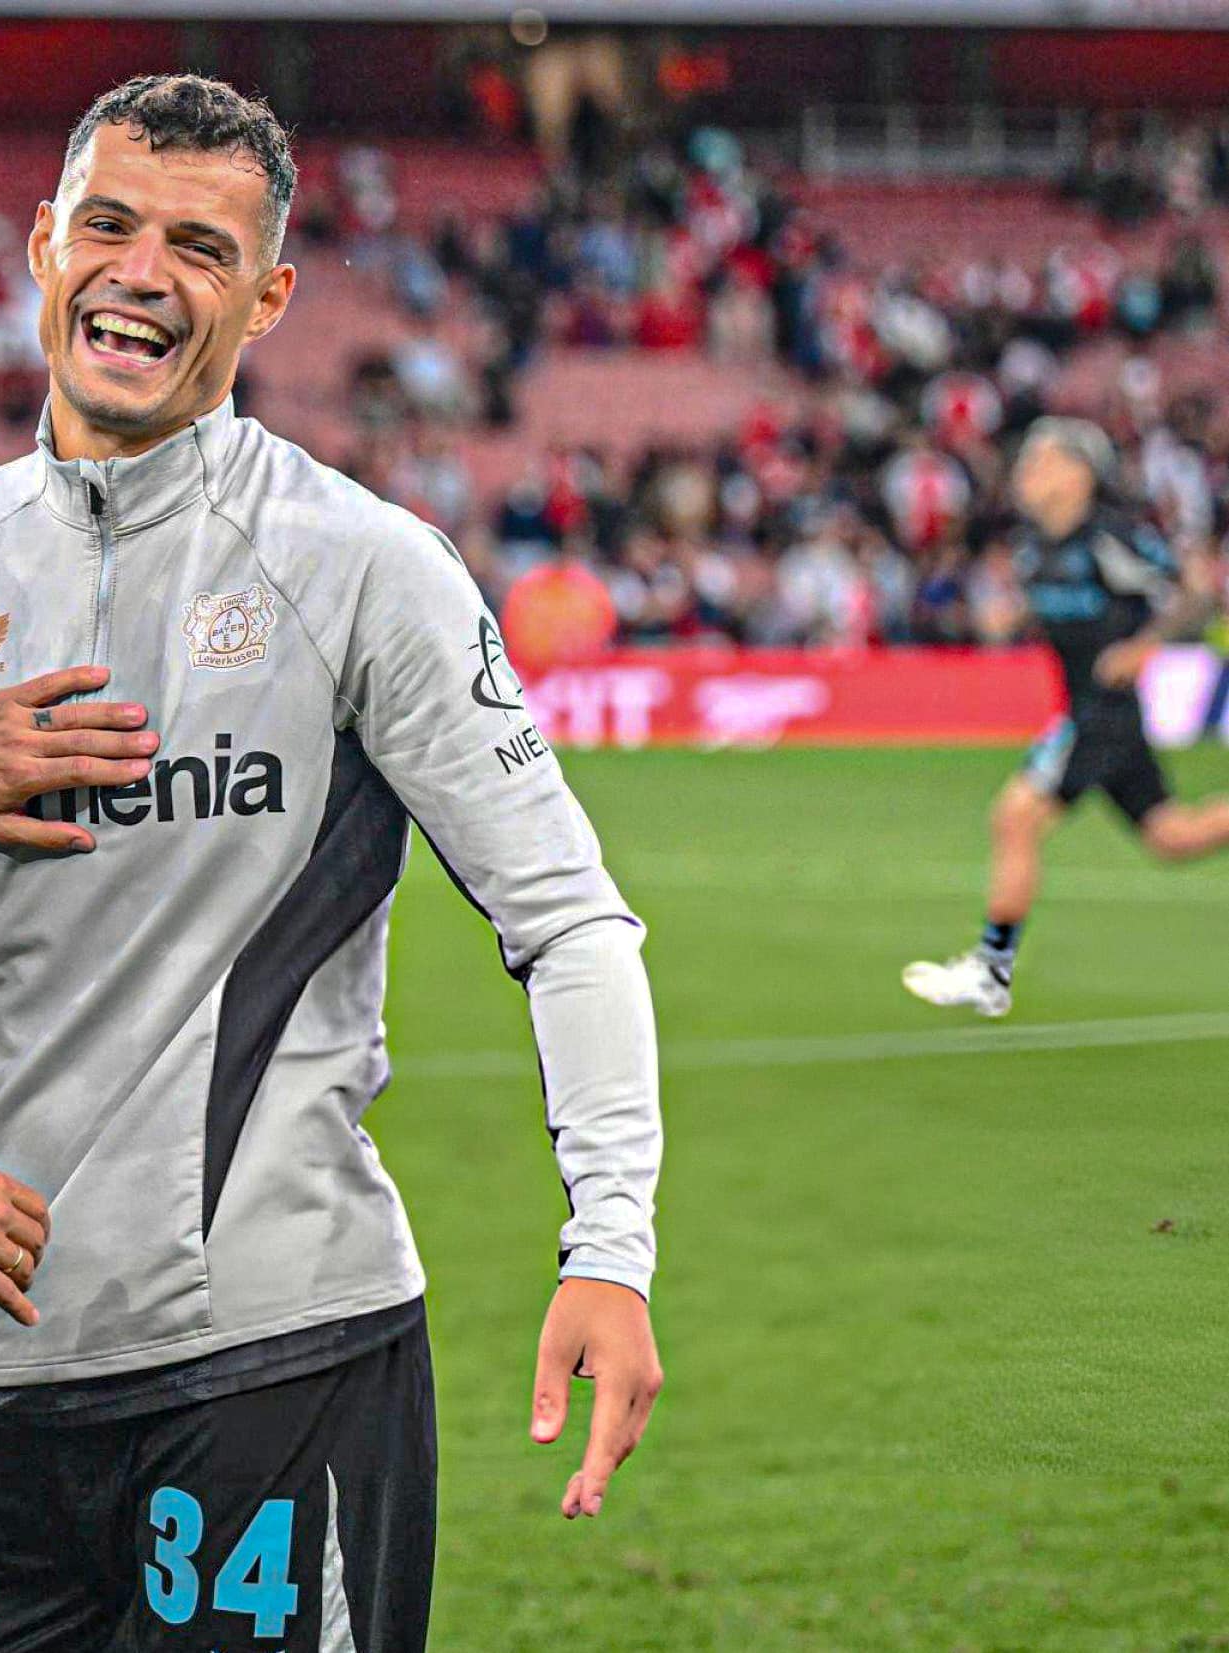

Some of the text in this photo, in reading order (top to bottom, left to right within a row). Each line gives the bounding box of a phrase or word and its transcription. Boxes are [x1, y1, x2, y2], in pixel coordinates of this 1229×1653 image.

[212, 623, 245, 637] BAYER
[197, 648, 260, 666] Leverkusen
[494, 724, 549, 774] NIE
[144, 1486, 299, 1638] 34
